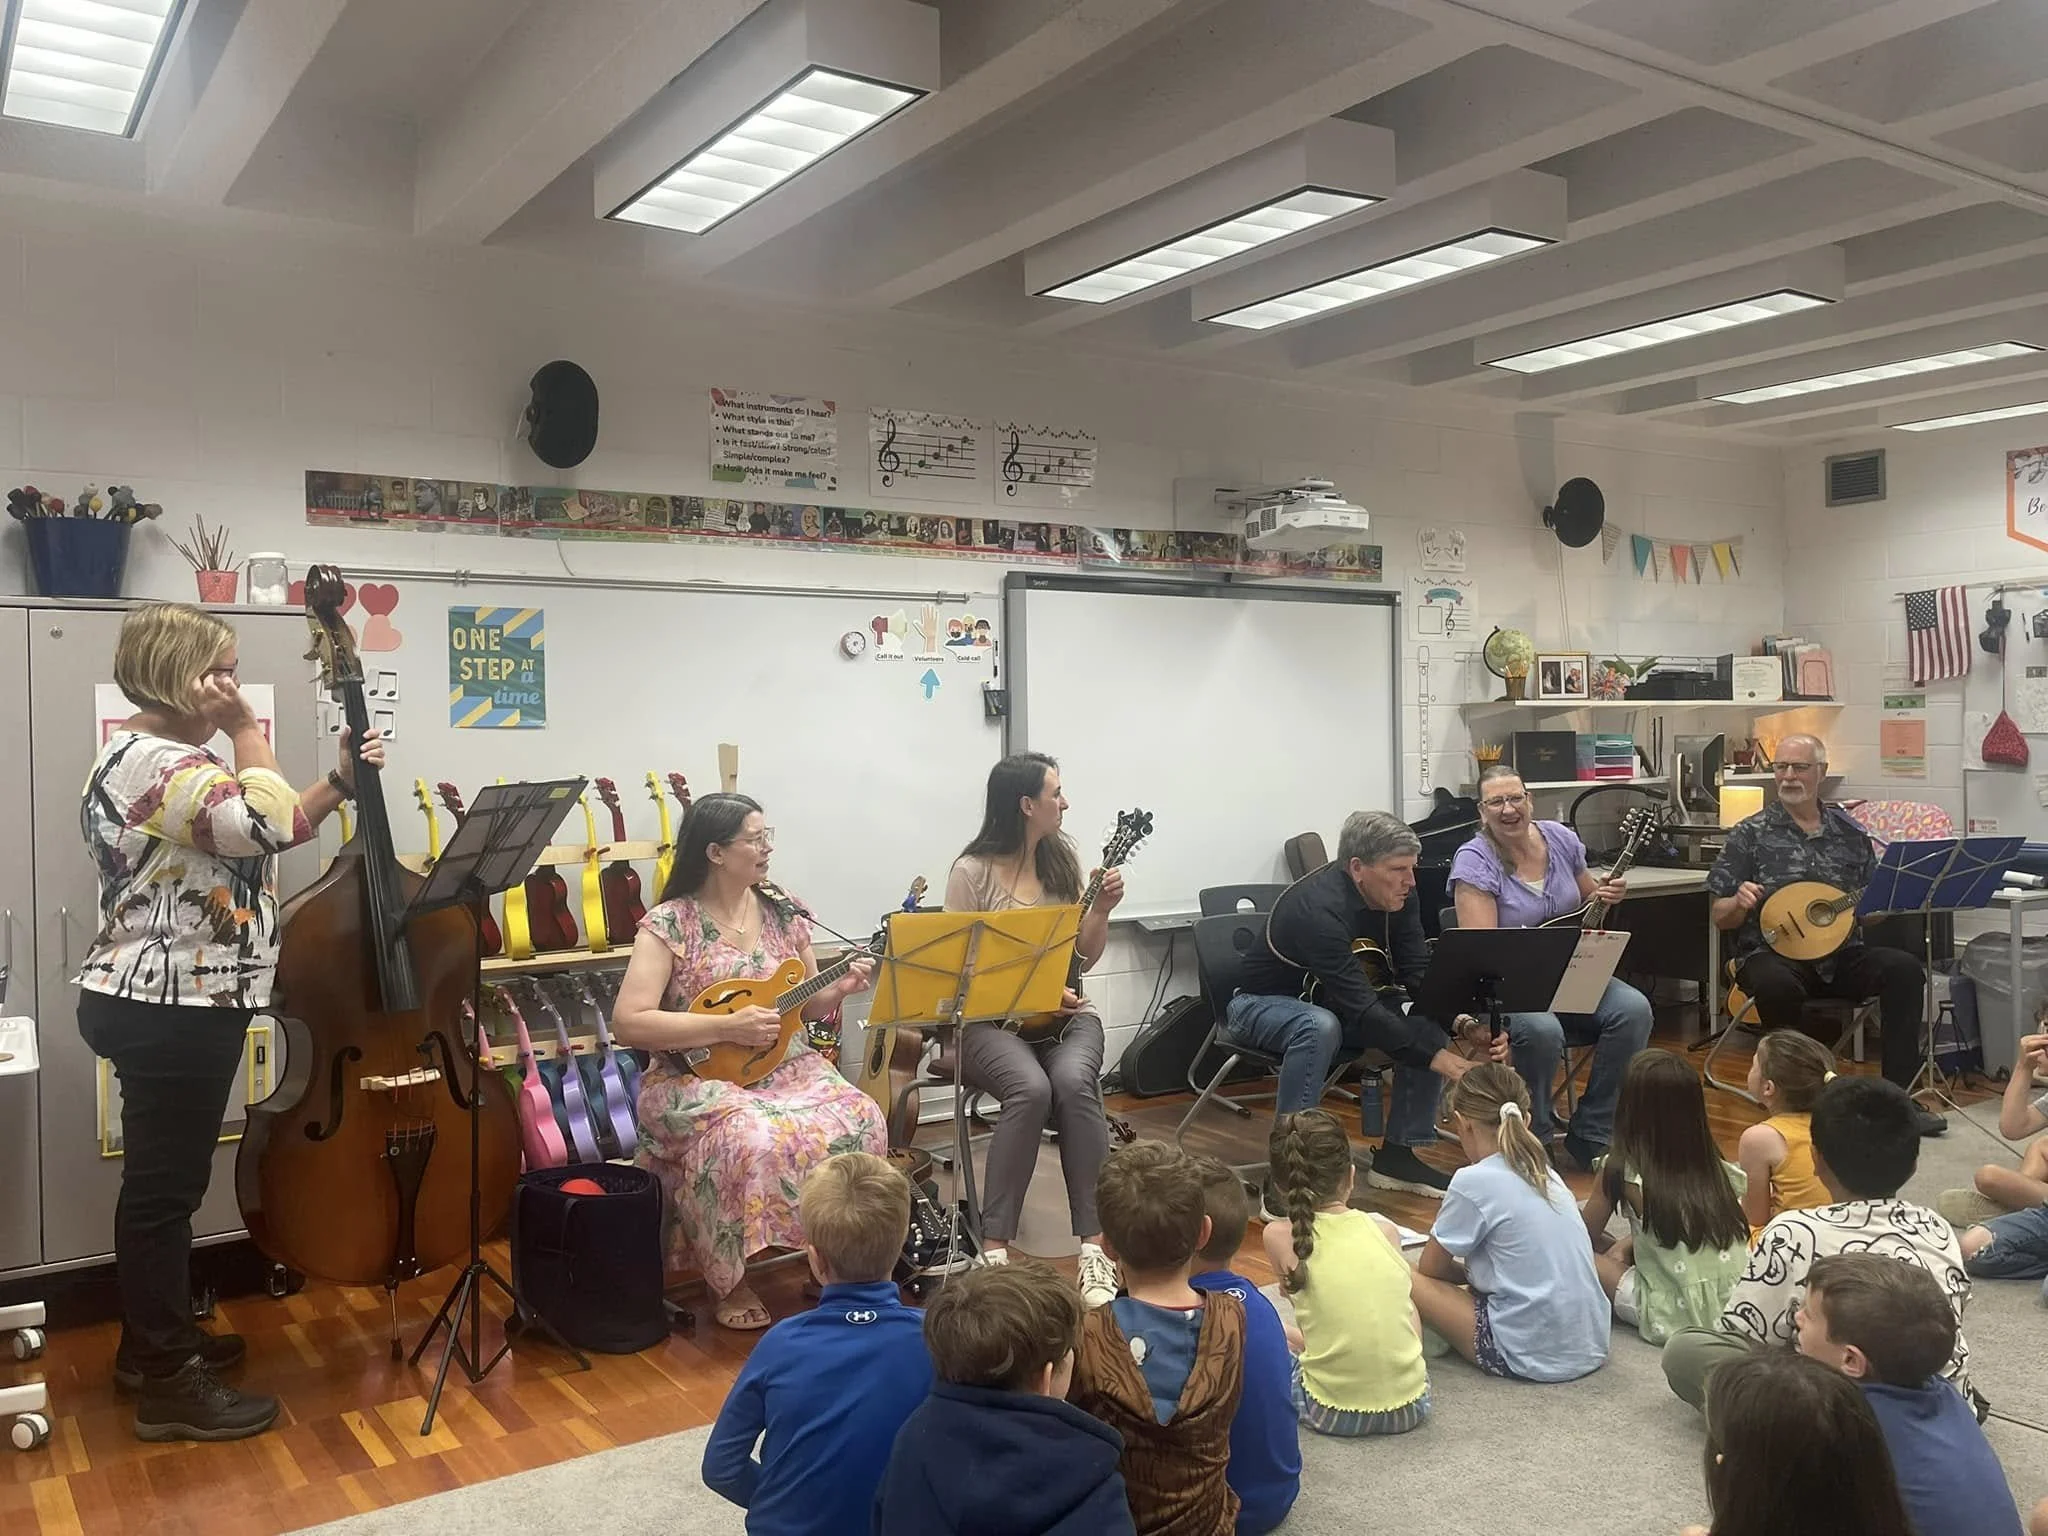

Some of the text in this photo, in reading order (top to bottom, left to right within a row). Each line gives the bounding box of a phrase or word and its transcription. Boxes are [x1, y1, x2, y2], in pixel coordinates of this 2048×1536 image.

[722, 400, 744, 410] What
[746, 402, 793, 414] instruments
[811, 409, 831, 418] hear?
[722, 412, 744, 420] What
[747, 415, 766, 424] style
[776, 418, 794, 426] this?
[722, 425, 745, 434] What
[748, 428, 773, 437] stands
[800, 434, 816, 442] me?
[723, 451, 790, 464] Simple/complex?
[782, 444, 831, 456] Strong/calm?
[723, 464, 742, 472] How
[744, 466, 762, 475] does
[772, 468, 793, 477] make
[808, 471, 827, 480] feel?
[453, 627, 500, 650] ONE
[460, 657, 534, 680] STEP AT
[521, 672, 535, 683] a
[494, 686, 540, 704] time
